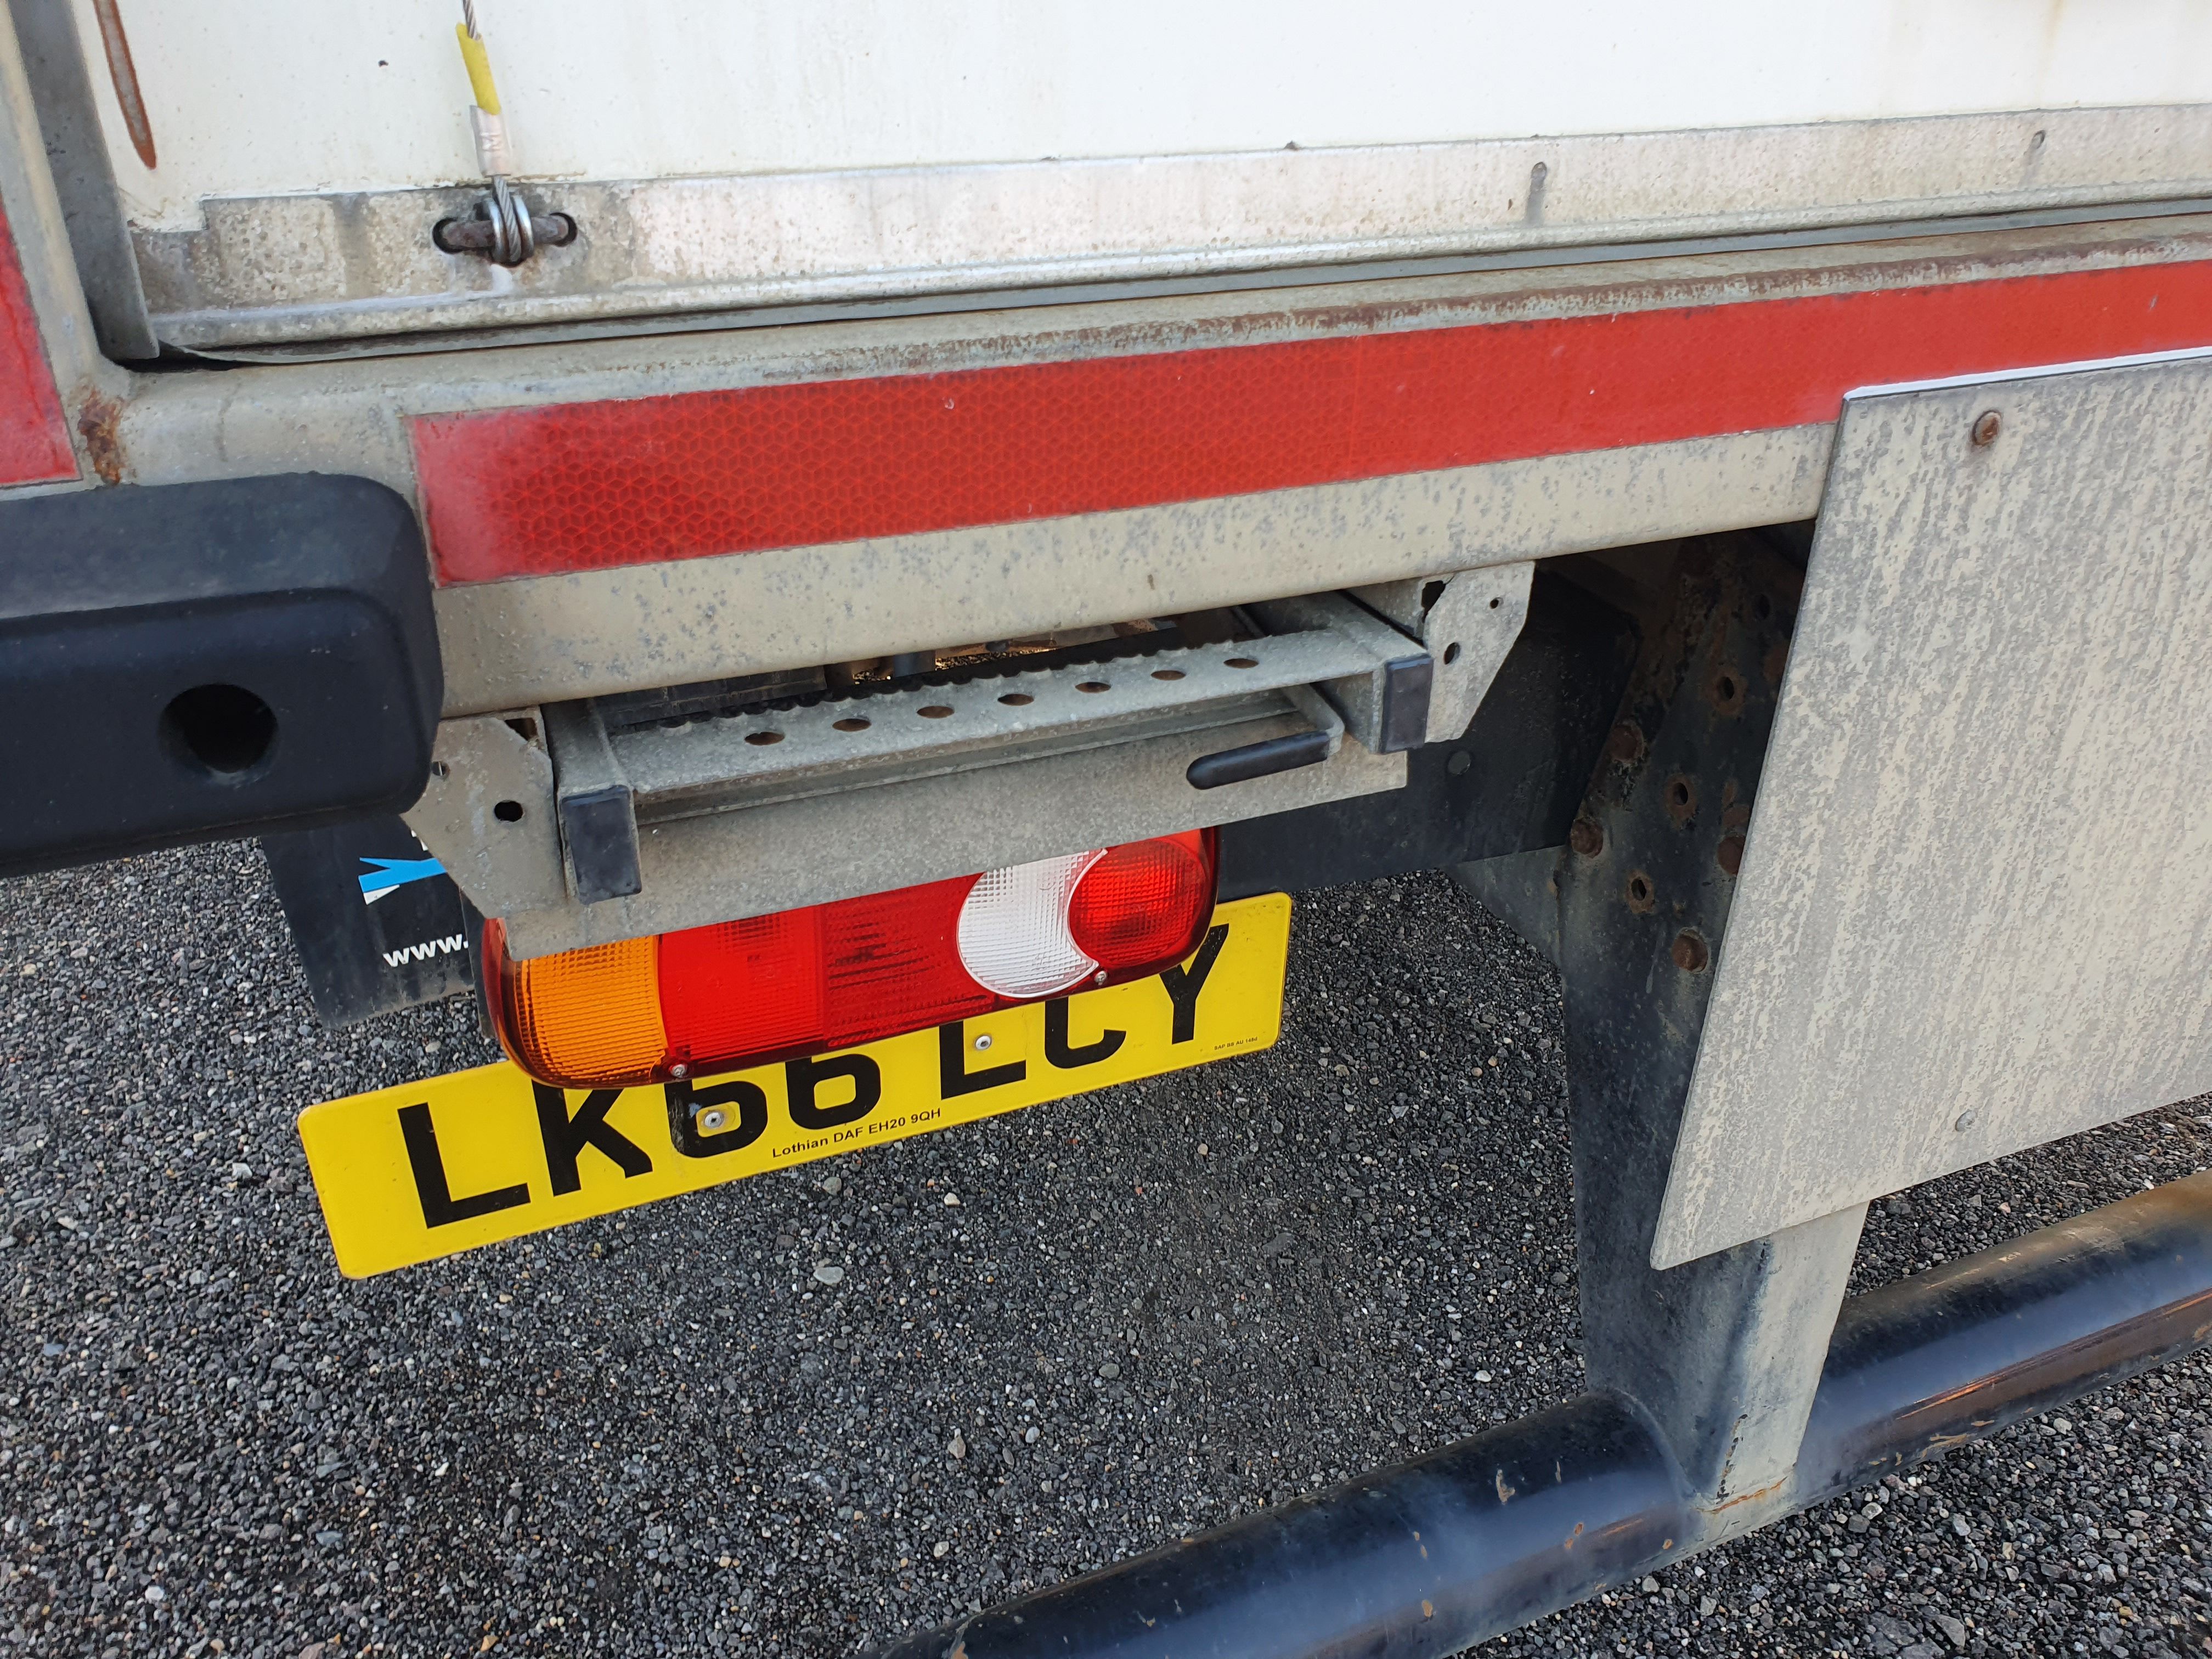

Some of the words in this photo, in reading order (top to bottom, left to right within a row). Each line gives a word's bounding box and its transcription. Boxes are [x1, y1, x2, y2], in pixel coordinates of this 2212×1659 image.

[398, 1053, 881, 1228] LK66
[772, 1138, 829, 1158] Lothian
[834, 1127, 864, 1143] DAF
[869, 1117, 905, 1135] EH20
[911, 1108, 941, 1124] 9QH
